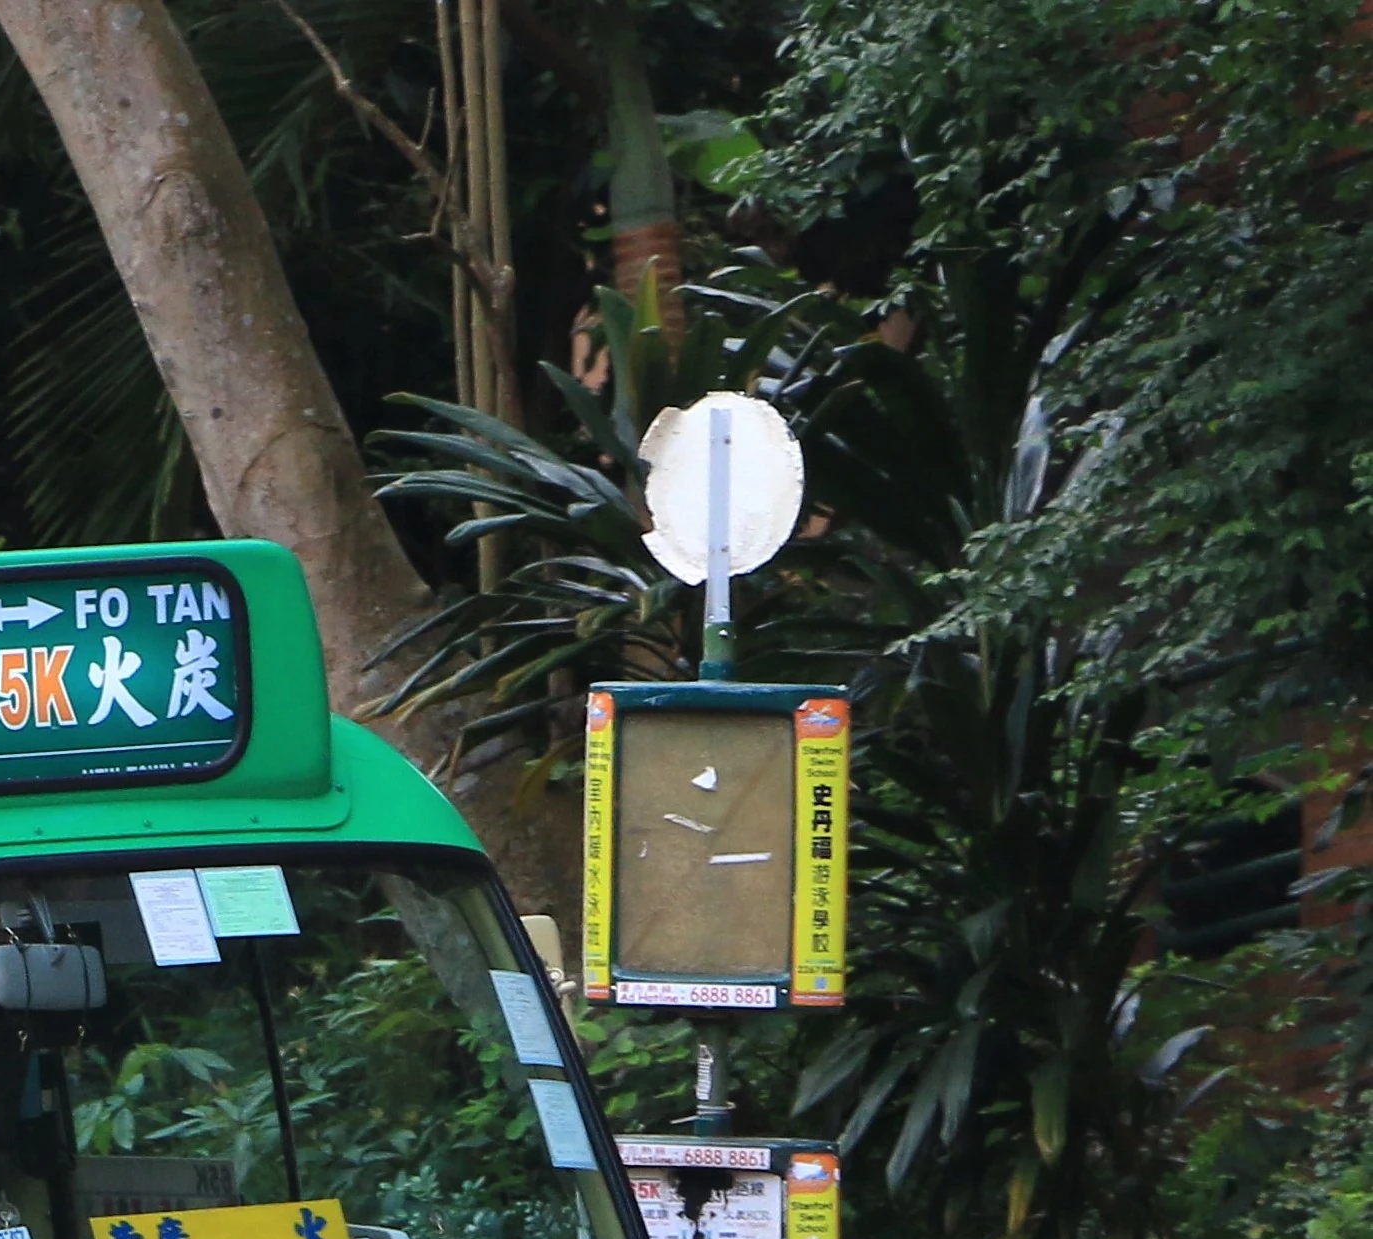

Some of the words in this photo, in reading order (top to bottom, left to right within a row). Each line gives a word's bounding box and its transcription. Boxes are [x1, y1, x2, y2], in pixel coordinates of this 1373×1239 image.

[75, 587, 130, 629] FO
[148, 581, 231, 625] TAN
[87, 628, 235, 729] 火炭
[690, 987, 730, 1003] 6888
[735, 988, 771, 1004] 8861
[684, 1148, 723, 1165] 6888
[729, 1150, 766, 1167] 8861
